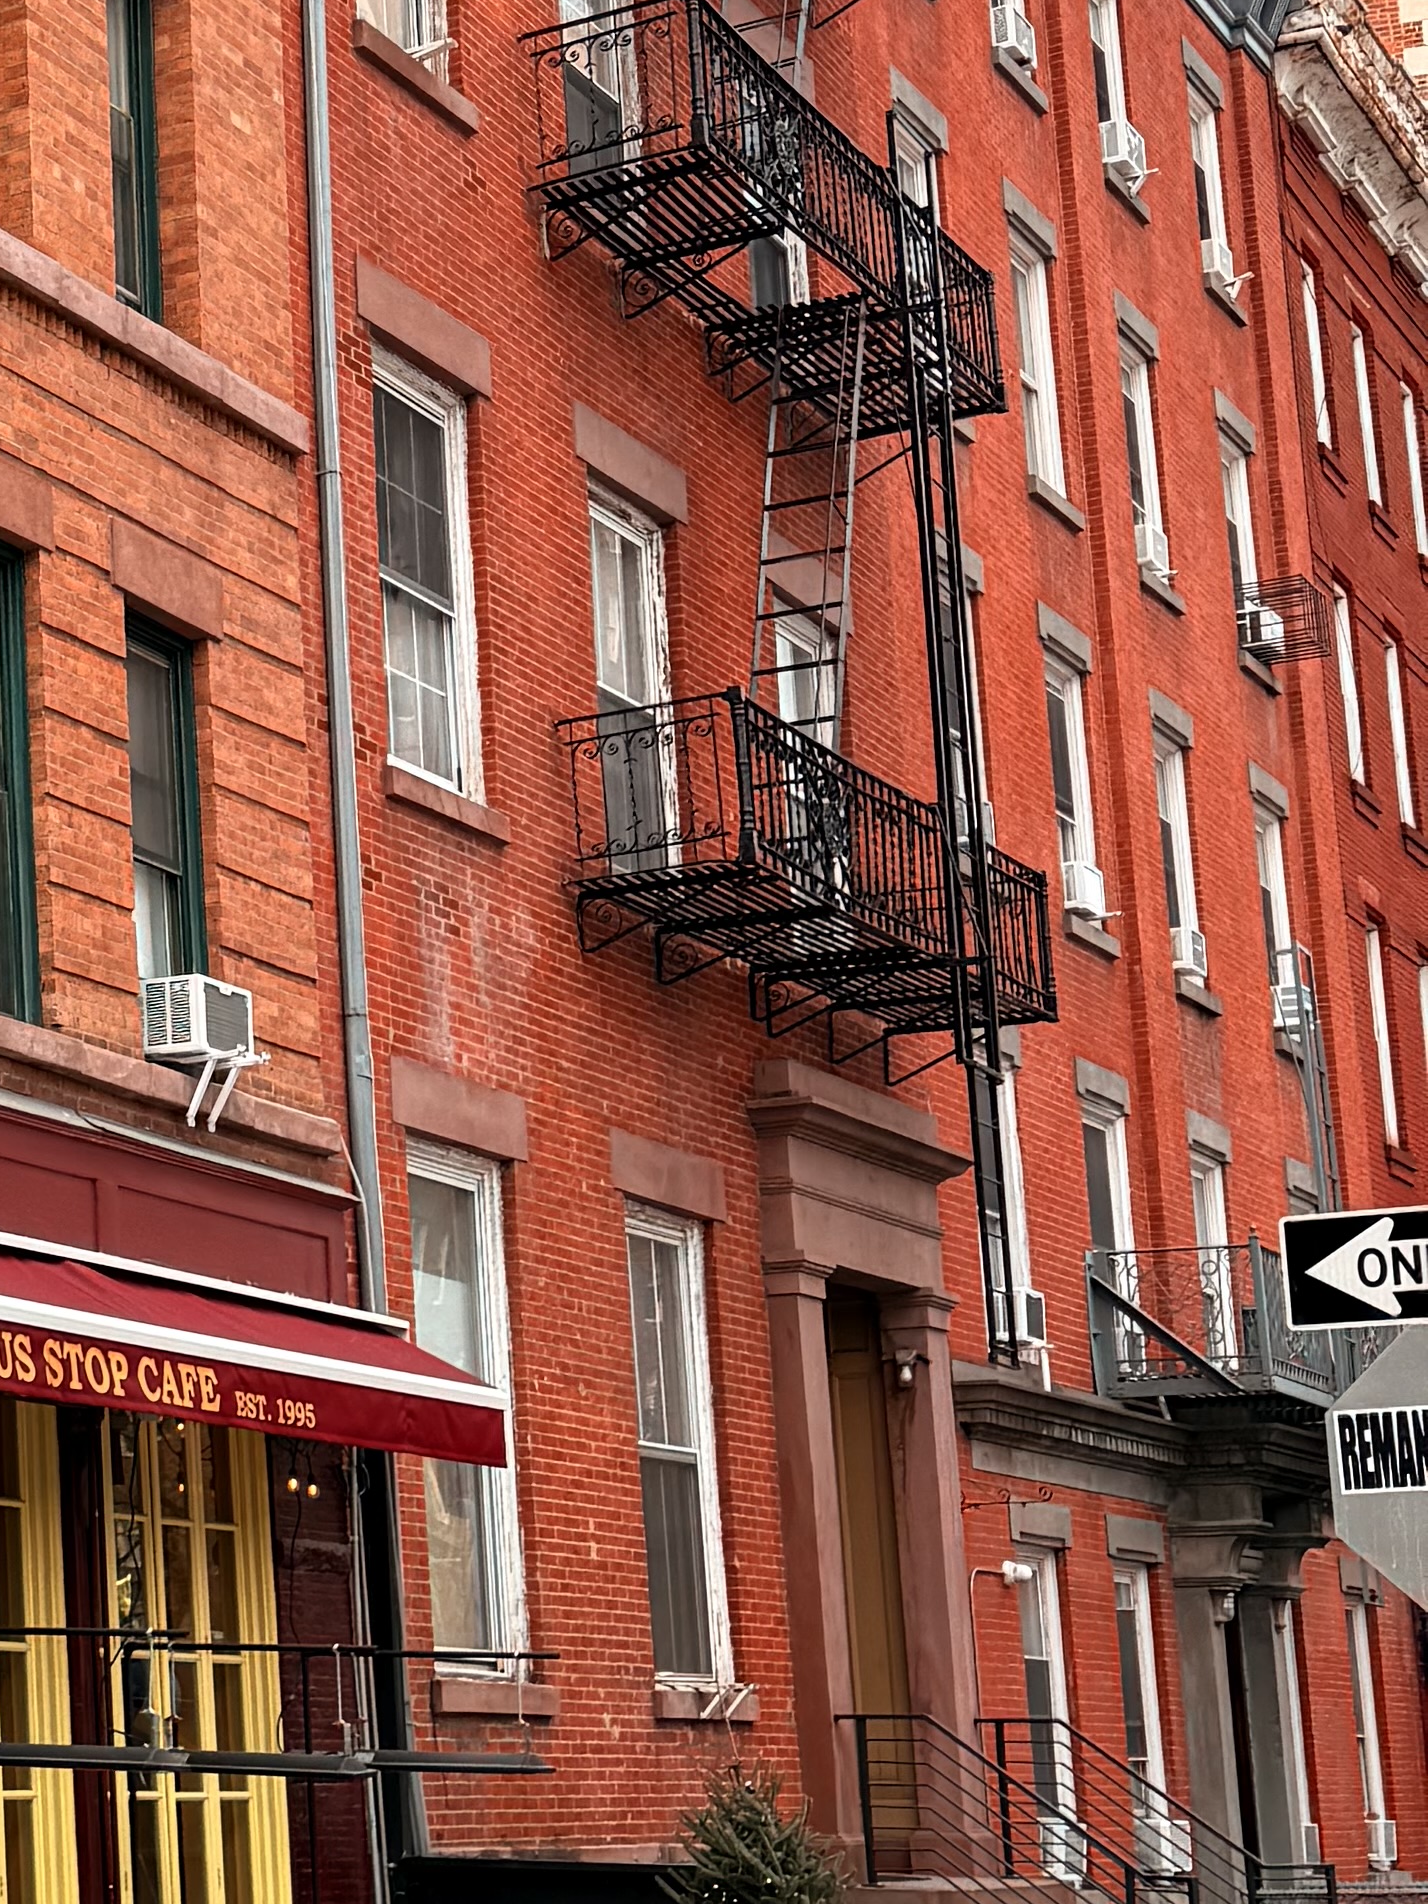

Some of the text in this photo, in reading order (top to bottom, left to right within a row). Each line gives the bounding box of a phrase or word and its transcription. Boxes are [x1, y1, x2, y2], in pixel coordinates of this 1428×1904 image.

[1357, 1244, 1428, 1288] ON
[43, 1338, 129, 1396] STOP
[138, 1356, 221, 1412] CAFE
[234, 1391, 272, 1422] EST.
[277, 1399, 316, 1429] 1995
